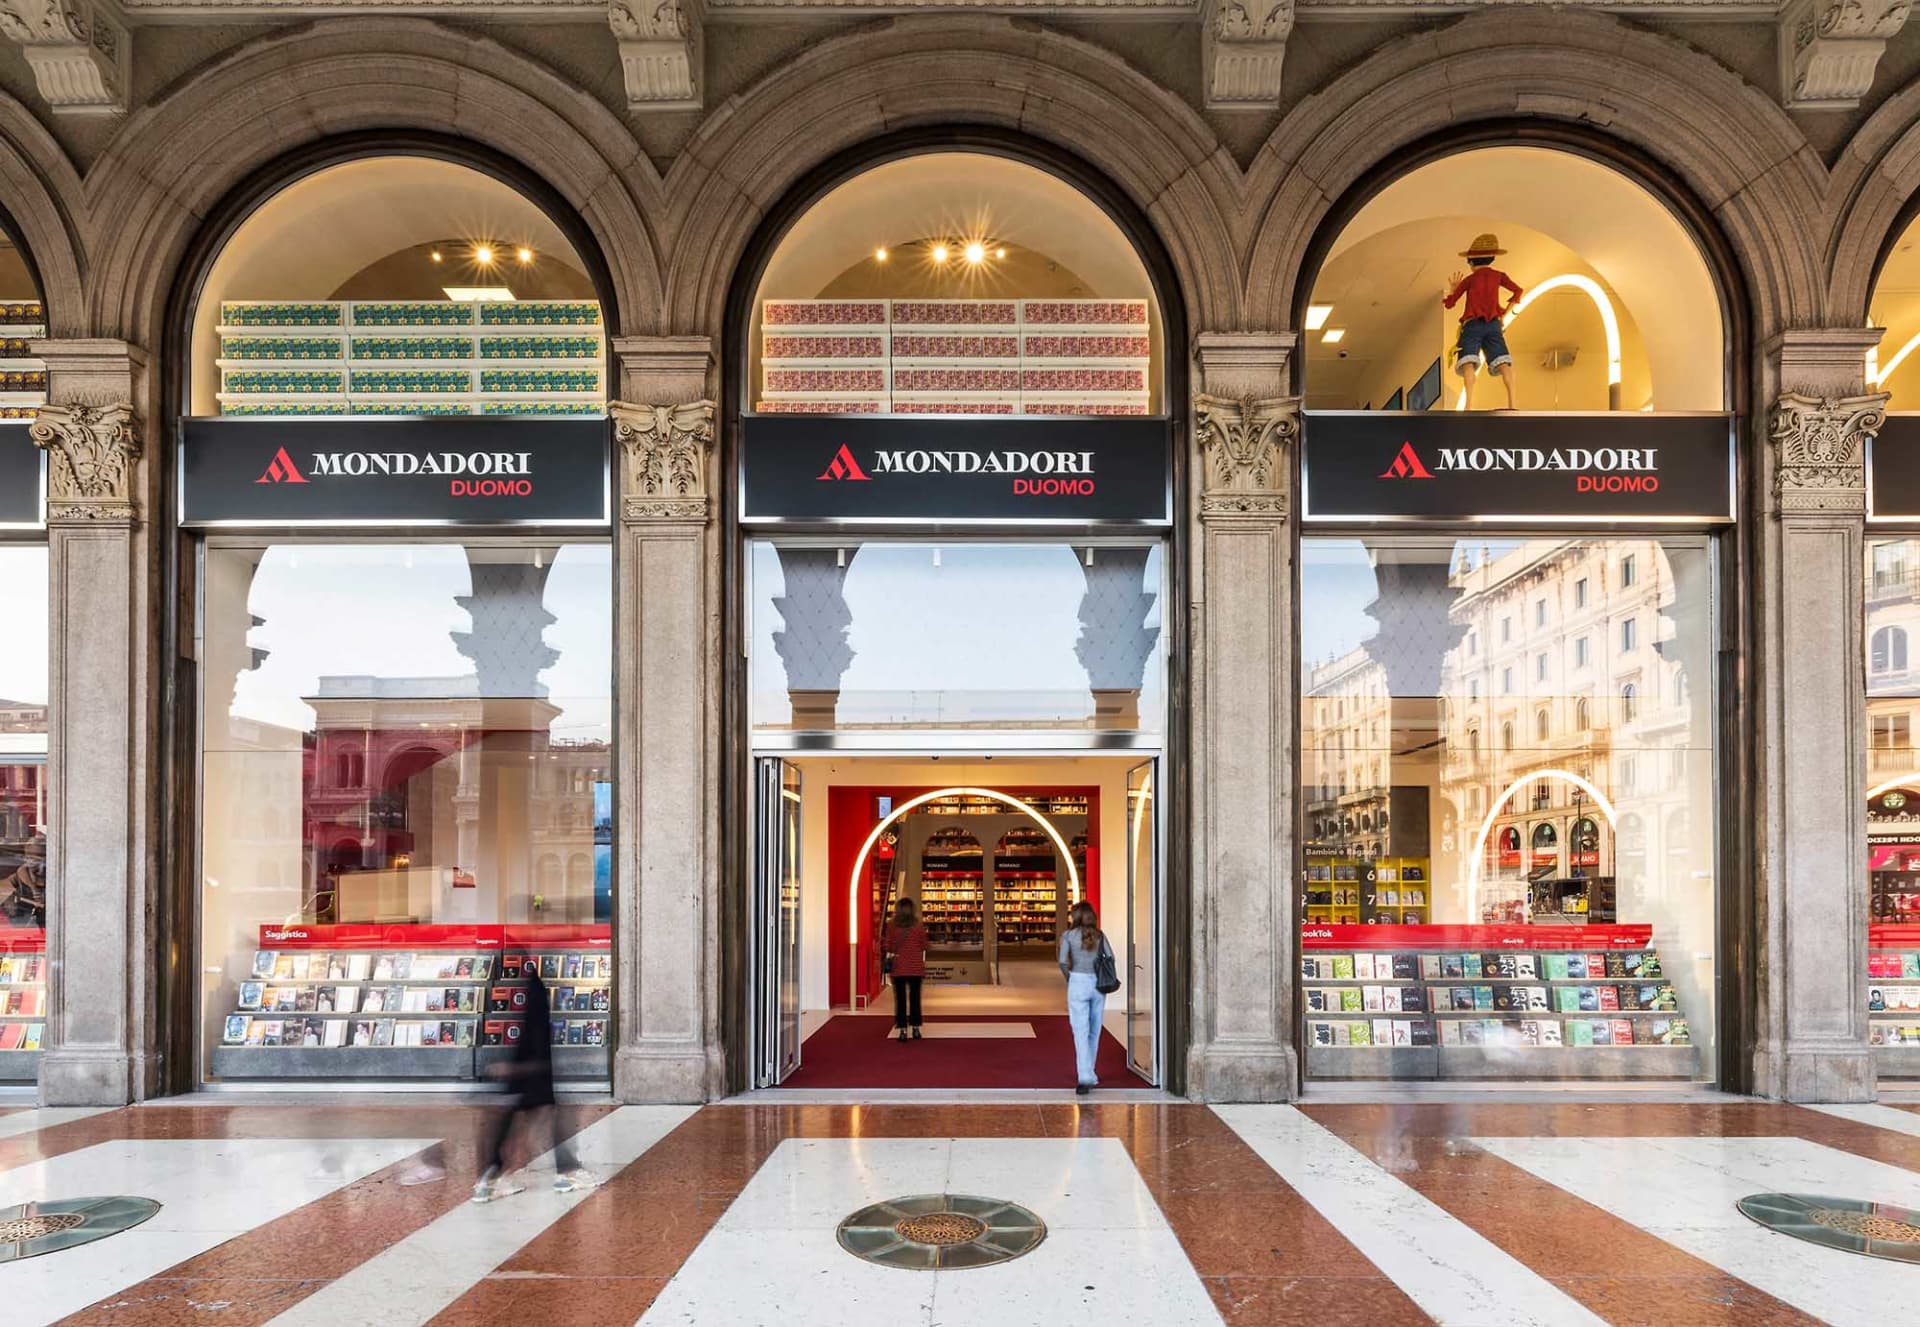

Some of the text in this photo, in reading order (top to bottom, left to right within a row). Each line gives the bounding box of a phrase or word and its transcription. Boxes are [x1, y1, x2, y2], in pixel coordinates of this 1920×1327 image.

[309, 452, 533, 475] MONDADORI
[871, 450, 1095, 473] MONDADORI
[1434, 448, 1659, 470] MONDADORI
[451, 479, 533, 496] DUOMO
[1013, 479, 1095, 496] DUOMO
[1576, 476, 1659, 493] DUOMO
[1306, 848, 1337, 856] Bambini
[1367, 870, 1376, 881] 6
[1367, 894, 1376, 905] 7
[265, 930, 307, 939] Saggistica
